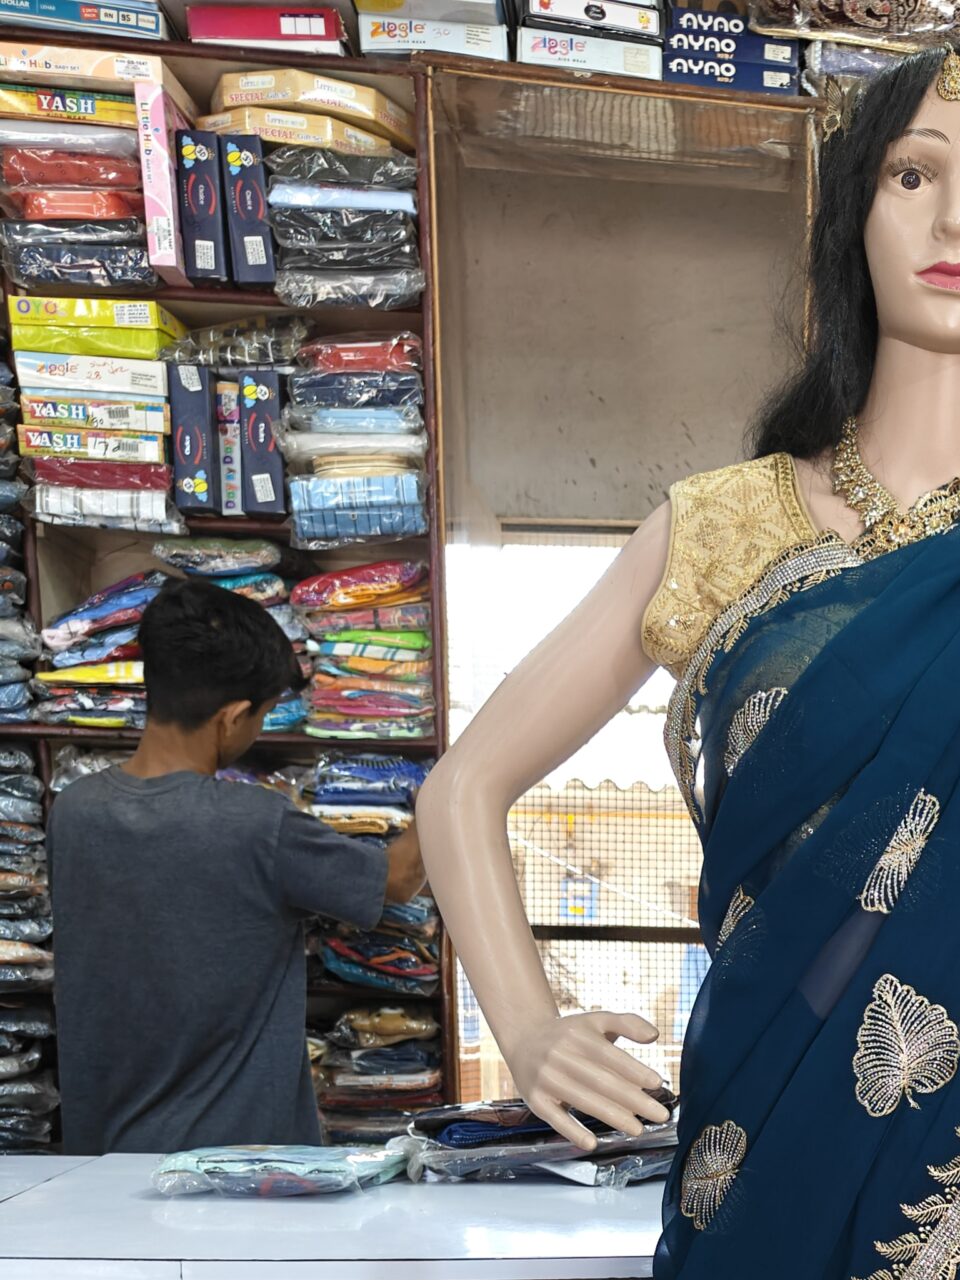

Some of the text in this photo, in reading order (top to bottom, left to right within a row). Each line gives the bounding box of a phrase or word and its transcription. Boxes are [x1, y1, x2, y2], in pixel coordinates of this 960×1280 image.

[29, 59, 52, 70] Hub
[38, 94, 95, 115] YASH
[31, 403, 87, 420] YASH
[27, 432, 81, 449] YASH
